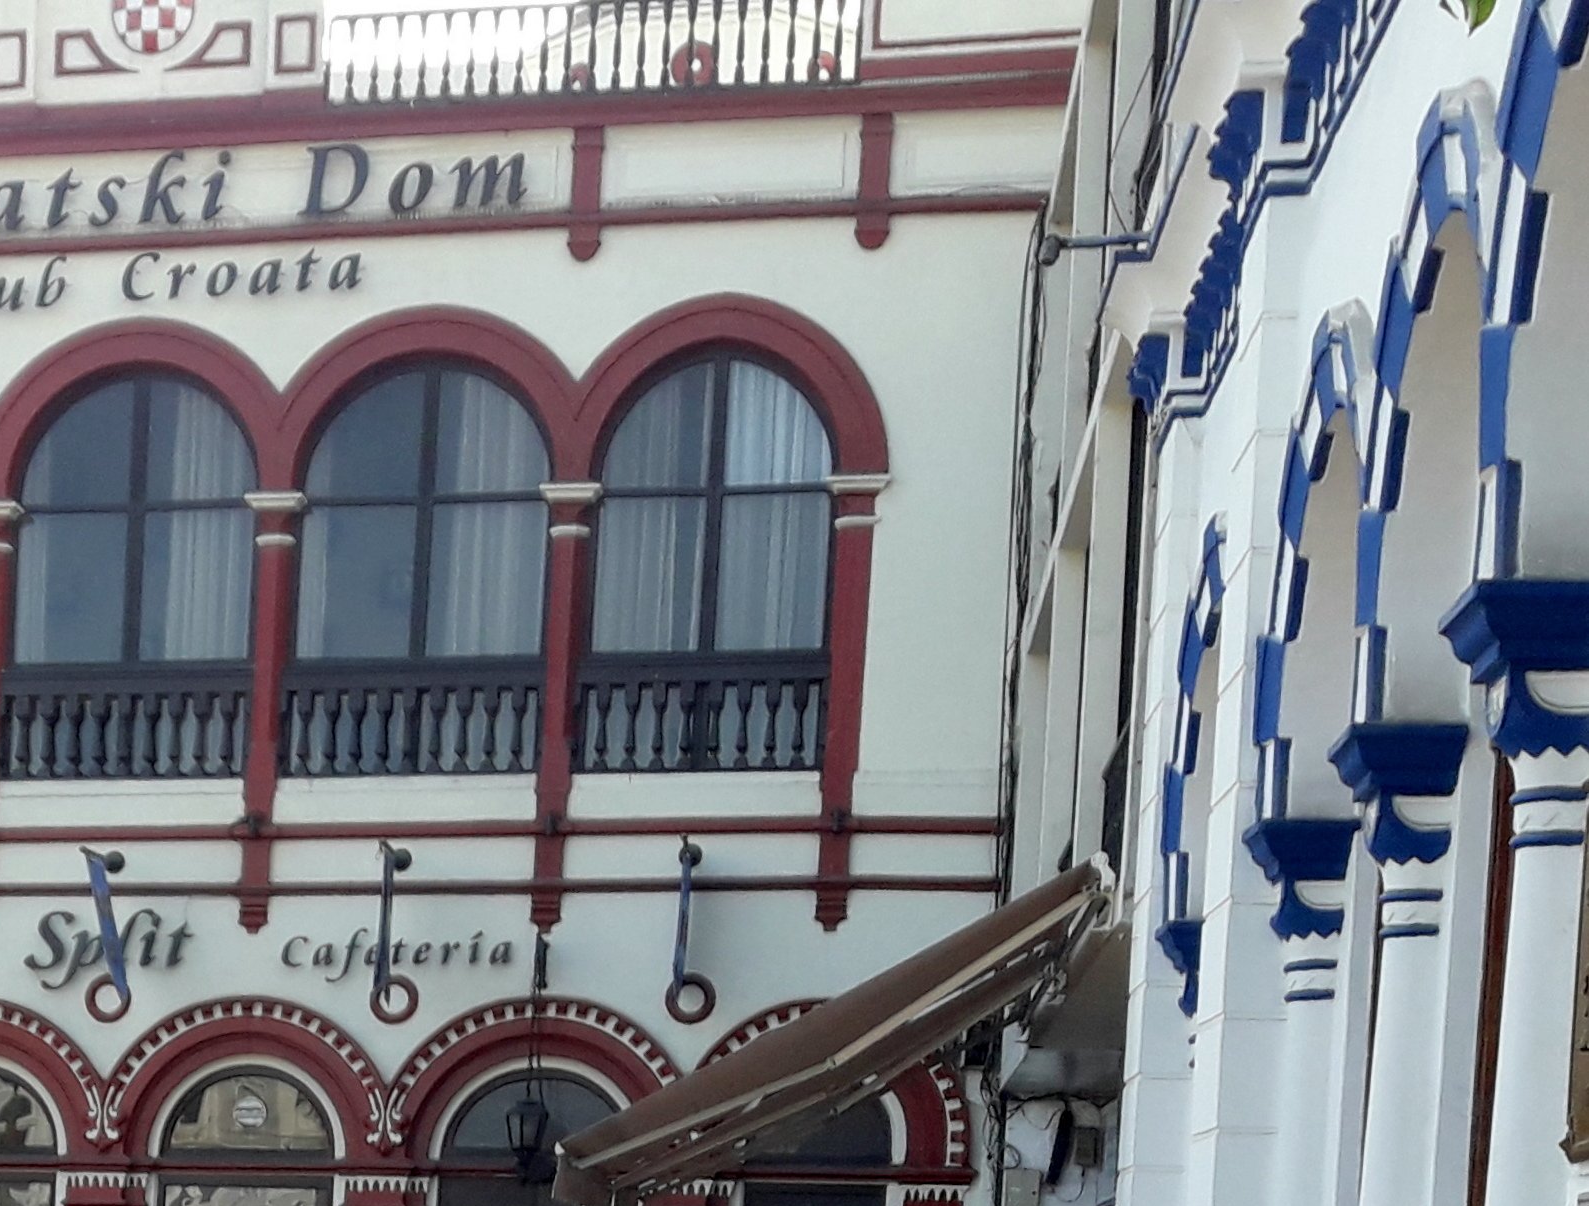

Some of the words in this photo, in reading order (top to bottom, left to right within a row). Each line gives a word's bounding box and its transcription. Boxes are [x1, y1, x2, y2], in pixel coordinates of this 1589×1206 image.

[296, 141, 529, 218] Dom
[121, 247, 363, 300] Croata
[23, 908, 194, 990] Split
